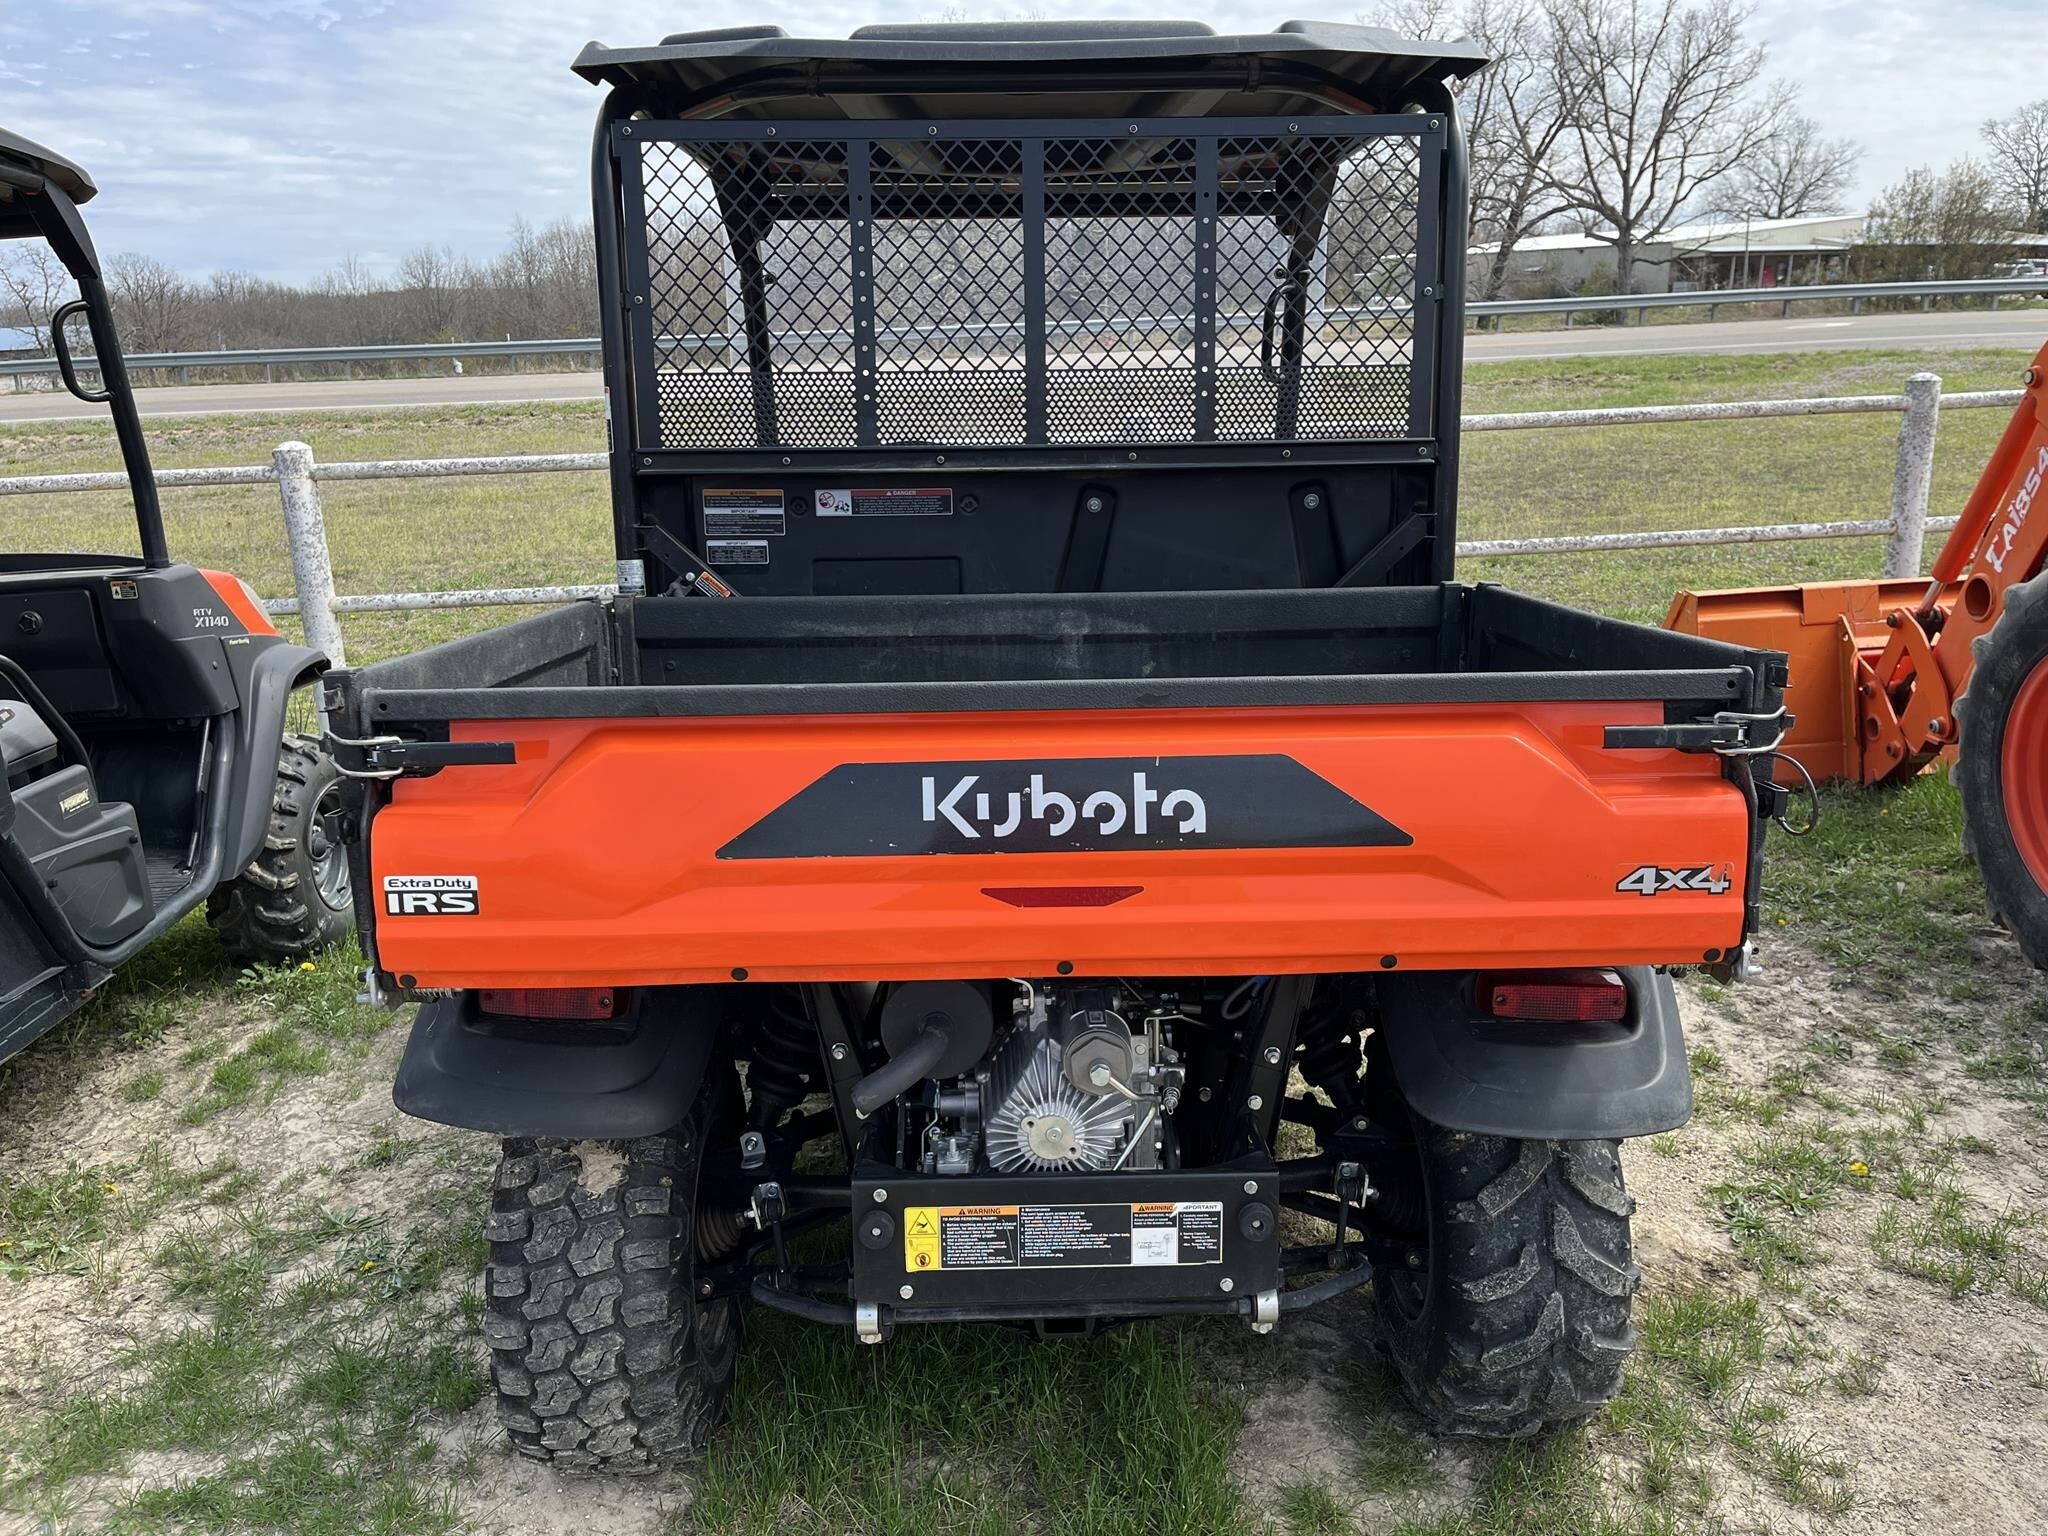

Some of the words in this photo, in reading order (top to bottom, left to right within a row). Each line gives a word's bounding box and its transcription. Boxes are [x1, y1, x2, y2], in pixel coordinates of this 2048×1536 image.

[193, 608, 212, 616] RTV
[194, 615, 229, 628] X1140
[922, 772, 1207, 838] Kubota
[388, 878, 431, 888] Extra
[433, 878, 472, 889] Duty
[1616, 865, 1732, 896] 4x4
[388, 893, 475, 914] IRS
